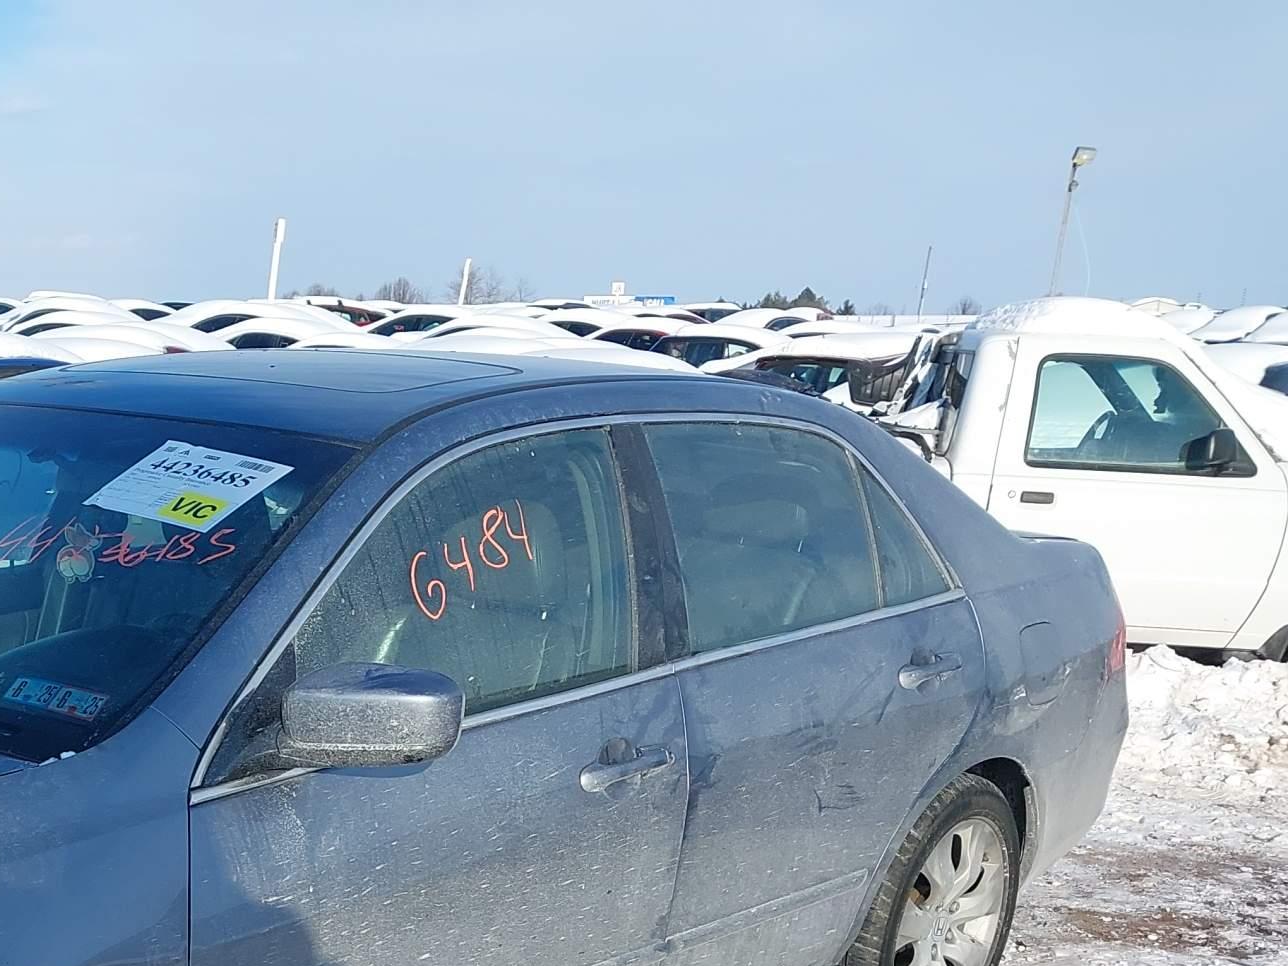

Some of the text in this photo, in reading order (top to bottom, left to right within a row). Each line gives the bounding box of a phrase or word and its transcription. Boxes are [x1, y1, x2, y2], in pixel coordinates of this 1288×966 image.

[150, 458, 257, 488] 44236485
[171, 496, 217, 519] VIC
[410, 498, 534, 620] 6484
[12, 680, 60, 704] 6 25
[56, 690, 105, 716] 6 25
